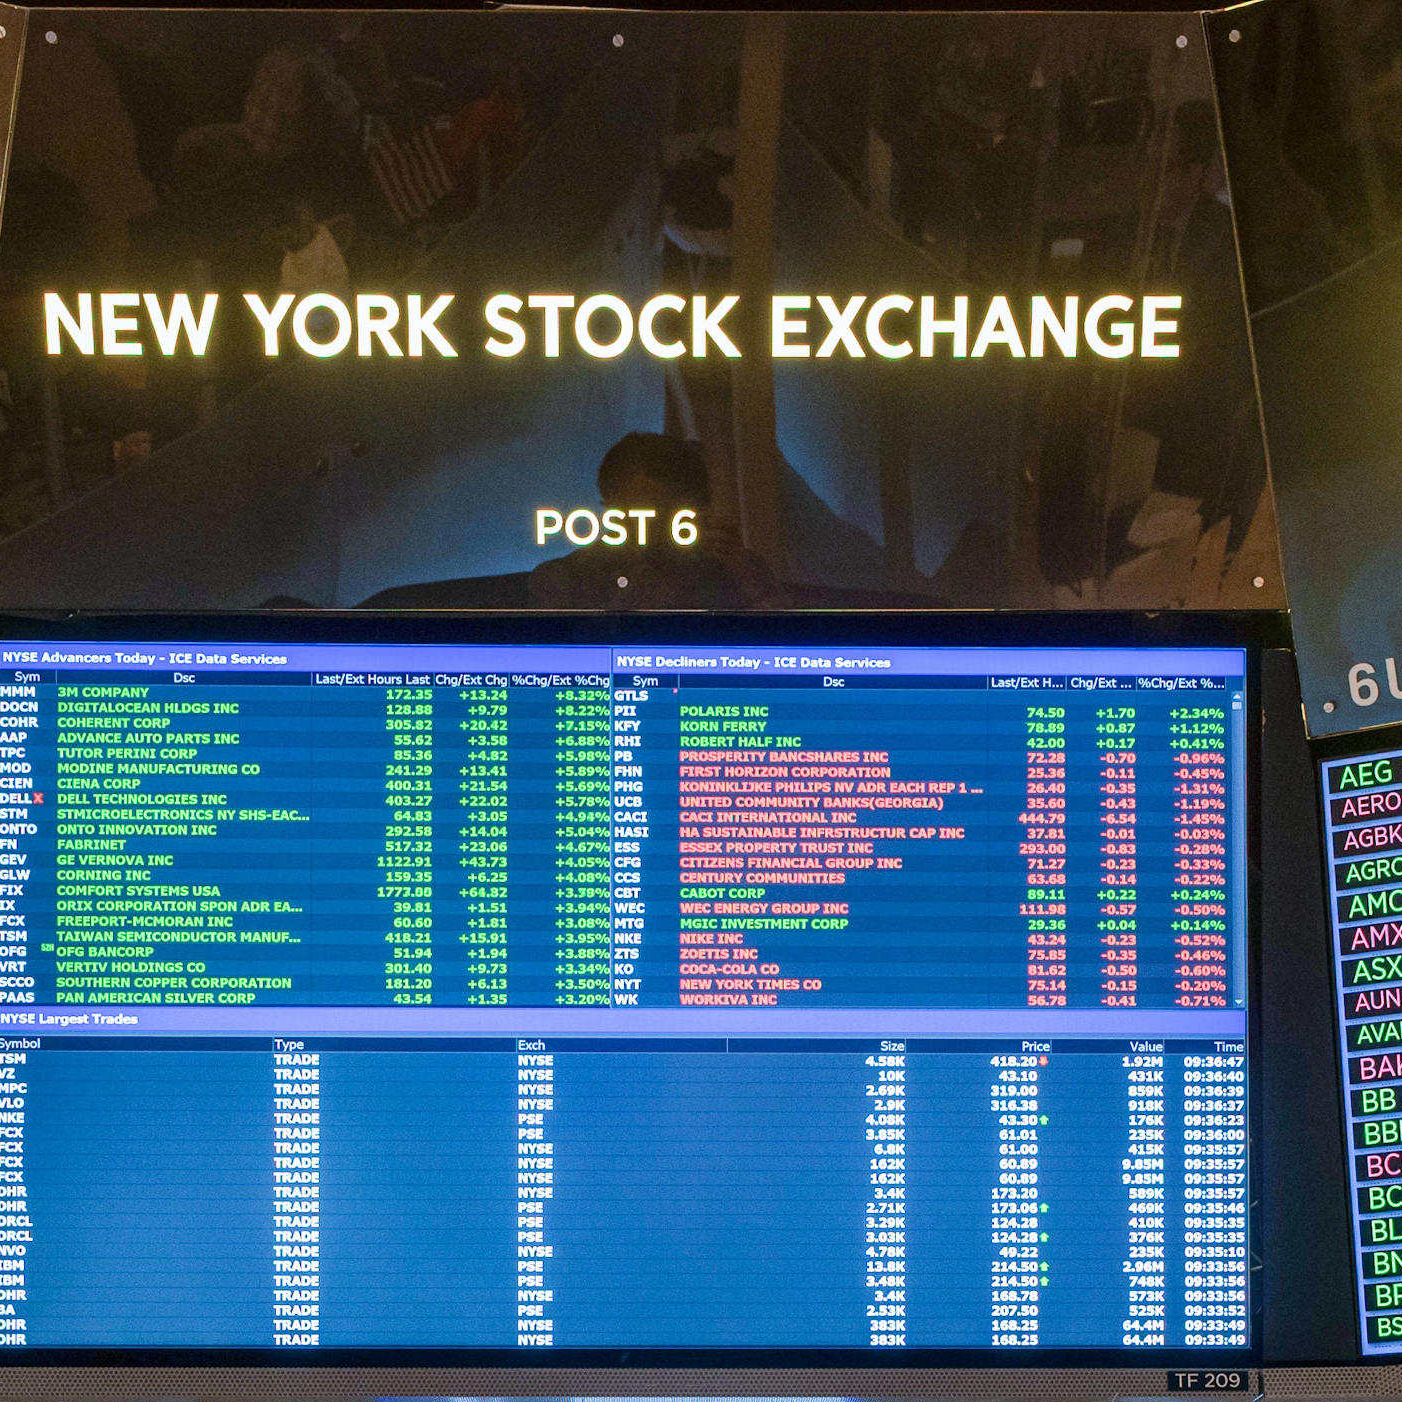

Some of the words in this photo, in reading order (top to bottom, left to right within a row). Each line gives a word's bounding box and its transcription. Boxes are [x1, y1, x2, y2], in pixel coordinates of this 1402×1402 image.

[44, 293, 219, 355] NEW
[243, 293, 458, 358] YORK
[485, 294, 742, 359] STOCK
[772, 294, 1181, 359] EXCHANGE
[537, 508, 656, 545] POST
[672, 510, 697, 545] 6
[3, 652, 37, 662] NYSE
[42, 652, 111, 663] Advancers
[115, 653, 155, 665] Today
[170, 653, 192, 663] ICE
[196, 654, 227, 664] Data
[231, 654, 287, 664] Services
[618, 656, 652, 666] NYSE
[656, 656, 717, 667] Decliners
[720, 656, 760, 669] Today
[774, 657, 796, 667] ICE
[801, 657, 831, 667] Data
[835, 657, 891, 667] Services
[0, 686, 35, 697] MMM
[58, 687, 78, 697] 3M
[82, 687, 149, 697] COMPANY
[387, 689, 432, 700] 172.35
[460, 690, 508, 700] +13.24
[556, 690, 611, 701] +8.32%
[615, 705, 636, 716] PII
[680, 706, 740, 716] POLARIS
[744, 707, 768, 717] INC
[1340, 760, 1392, 789] AEG
[56, 931, 113, 942] TAIWAN
[117, 931, 237, 942] SEMICONDUCTOR
[240, 932, 300, 942] MANUF...
[615, 964, 634, 974] KO
[680, 964, 757, 974] COCA-COLA
[760, 964, 779, 975] CO
[1, 1014, 35, 1024] NYSE
[39, 1014, 89, 1026] Largest
[92, 1014, 138, 1024] Trades
[273, 1039, 304, 1053] Type
[1214, 1041, 1245, 1052] Time
[274, 1054, 319, 1065] TRADE
[518, 1055, 553, 1066] NYSE
[865, 1056, 905, 1066] 4.58K
[990, 1056, 1037, 1067] 418.20
[1123, 1056, 1163, 1067] 1.92M
[1184, 1056, 1244, 1067] 09:36:47
[1175, 1373, 1198, 1387] TF
[1205, 1373, 1240, 1387] 209
